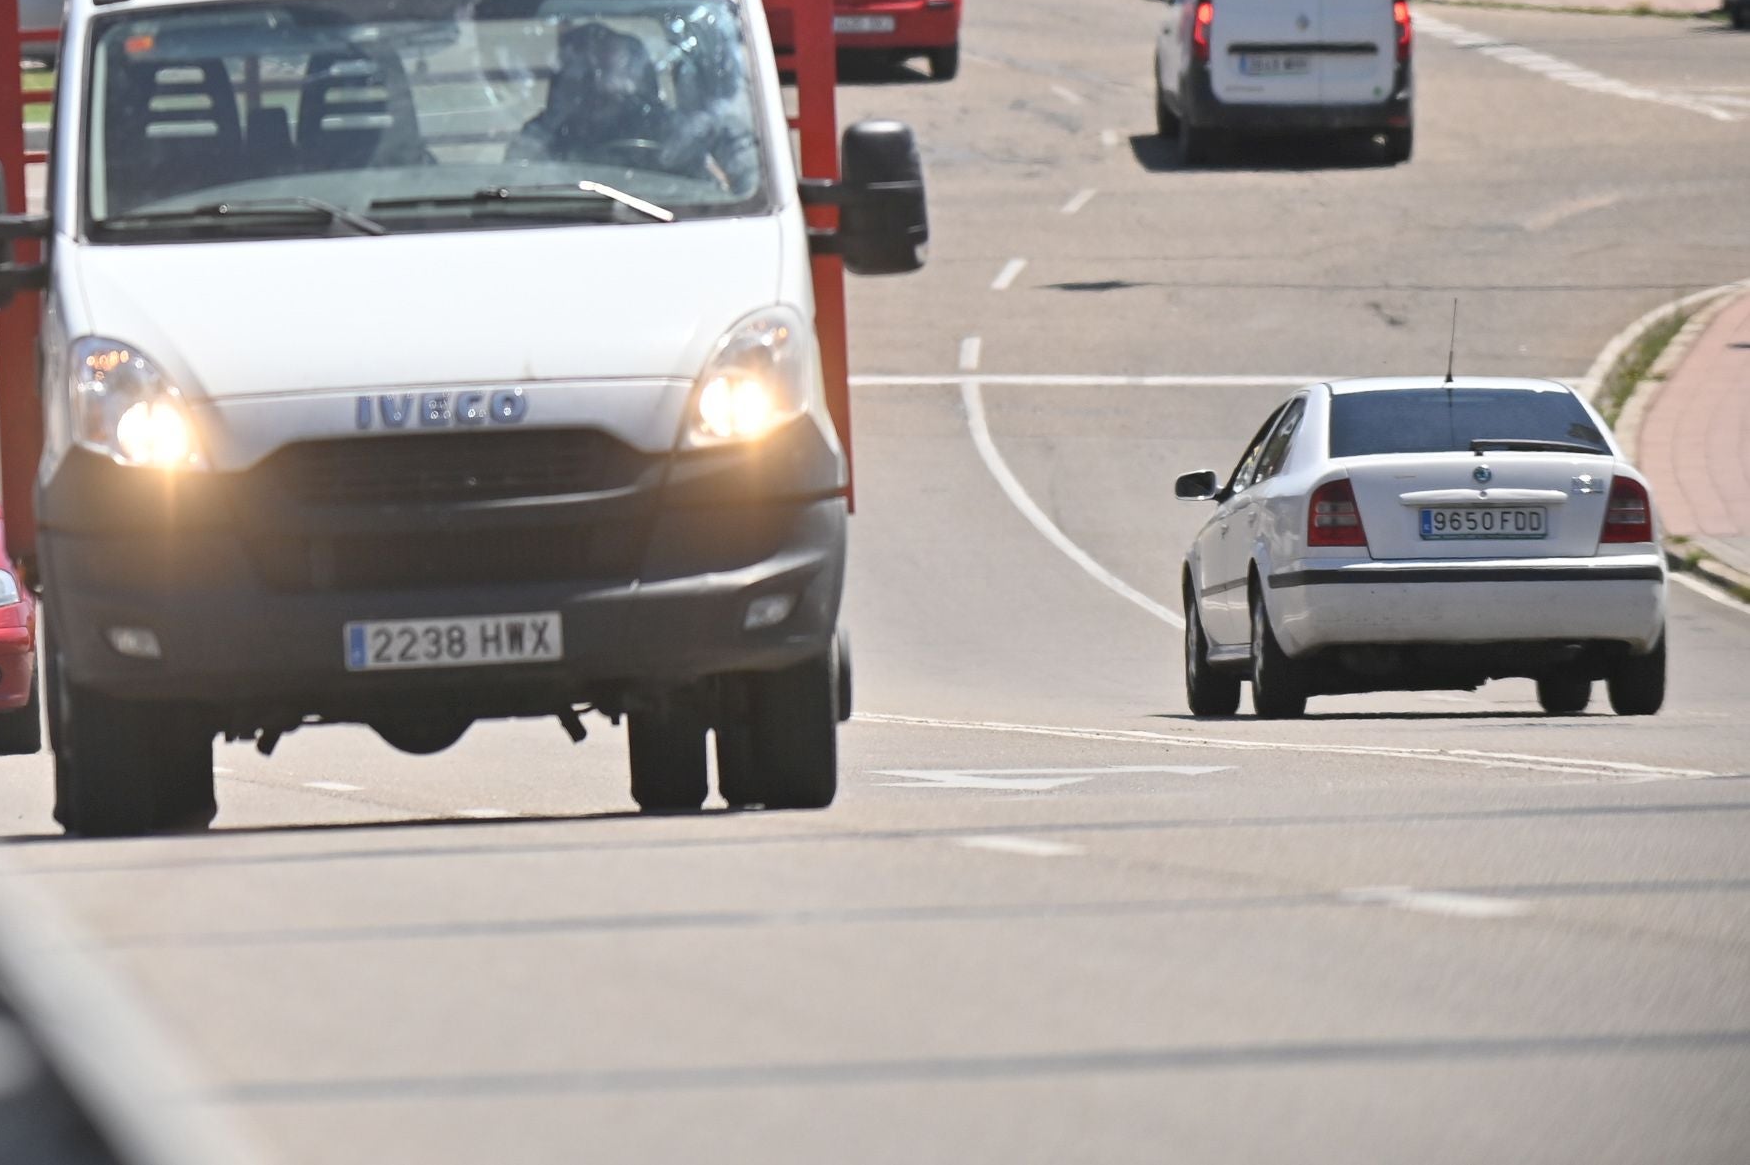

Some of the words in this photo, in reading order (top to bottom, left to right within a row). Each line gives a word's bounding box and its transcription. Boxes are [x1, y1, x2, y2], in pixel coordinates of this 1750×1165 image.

[355, 389, 528, 430] IVECO
[1433, 510, 1494, 532] 9650
[1500, 510, 1542, 532] FDD
[371, 625, 468, 663] 2238
[479, 620, 551, 657] HWX
